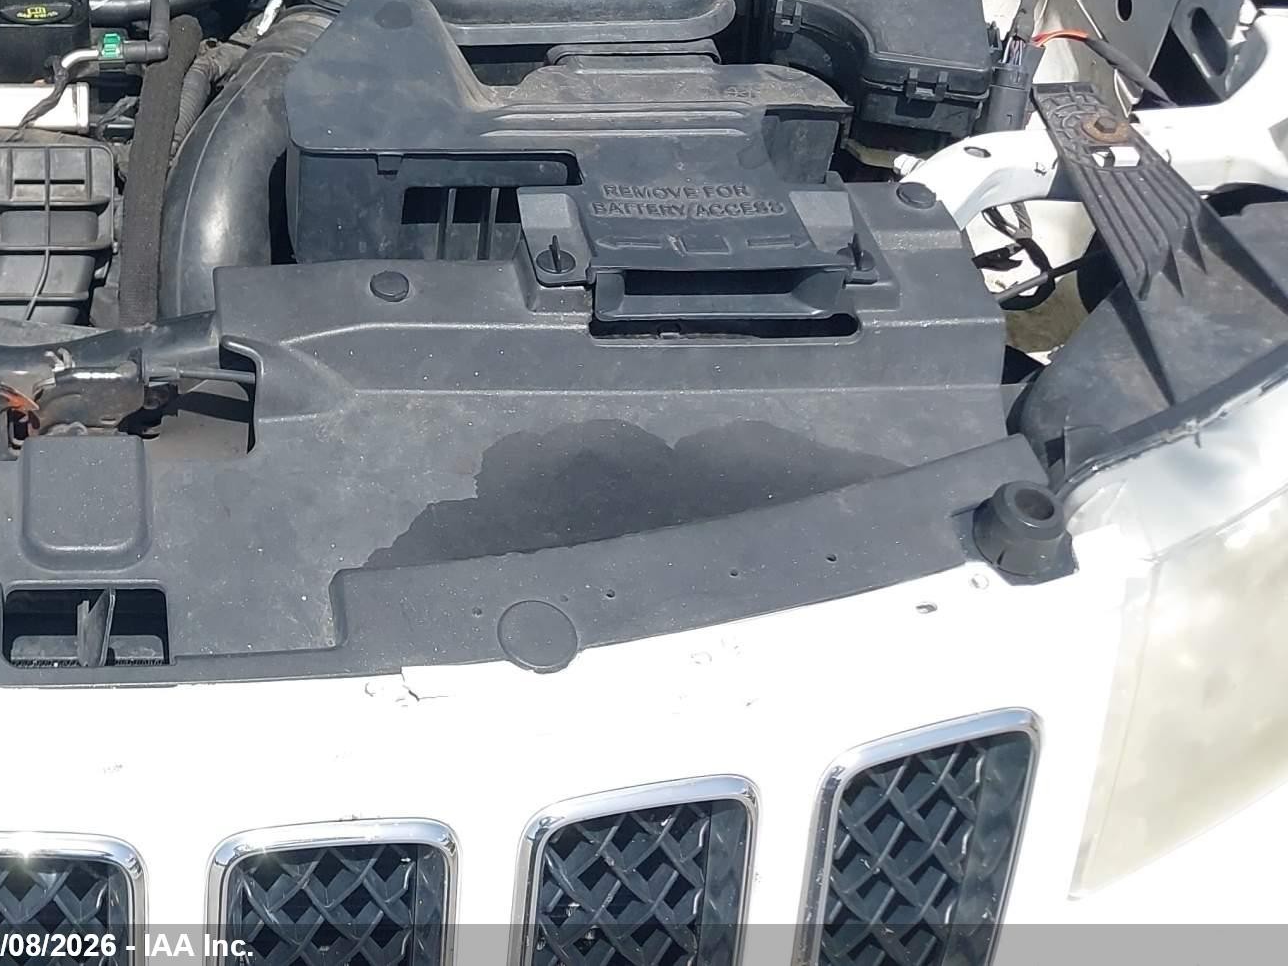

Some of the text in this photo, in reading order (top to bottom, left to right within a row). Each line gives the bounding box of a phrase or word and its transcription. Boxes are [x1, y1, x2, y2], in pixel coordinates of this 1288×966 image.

[602, 184, 751, 200] REMOVE FOR
[592, 201, 784, 217] BATTERY ACCESS
